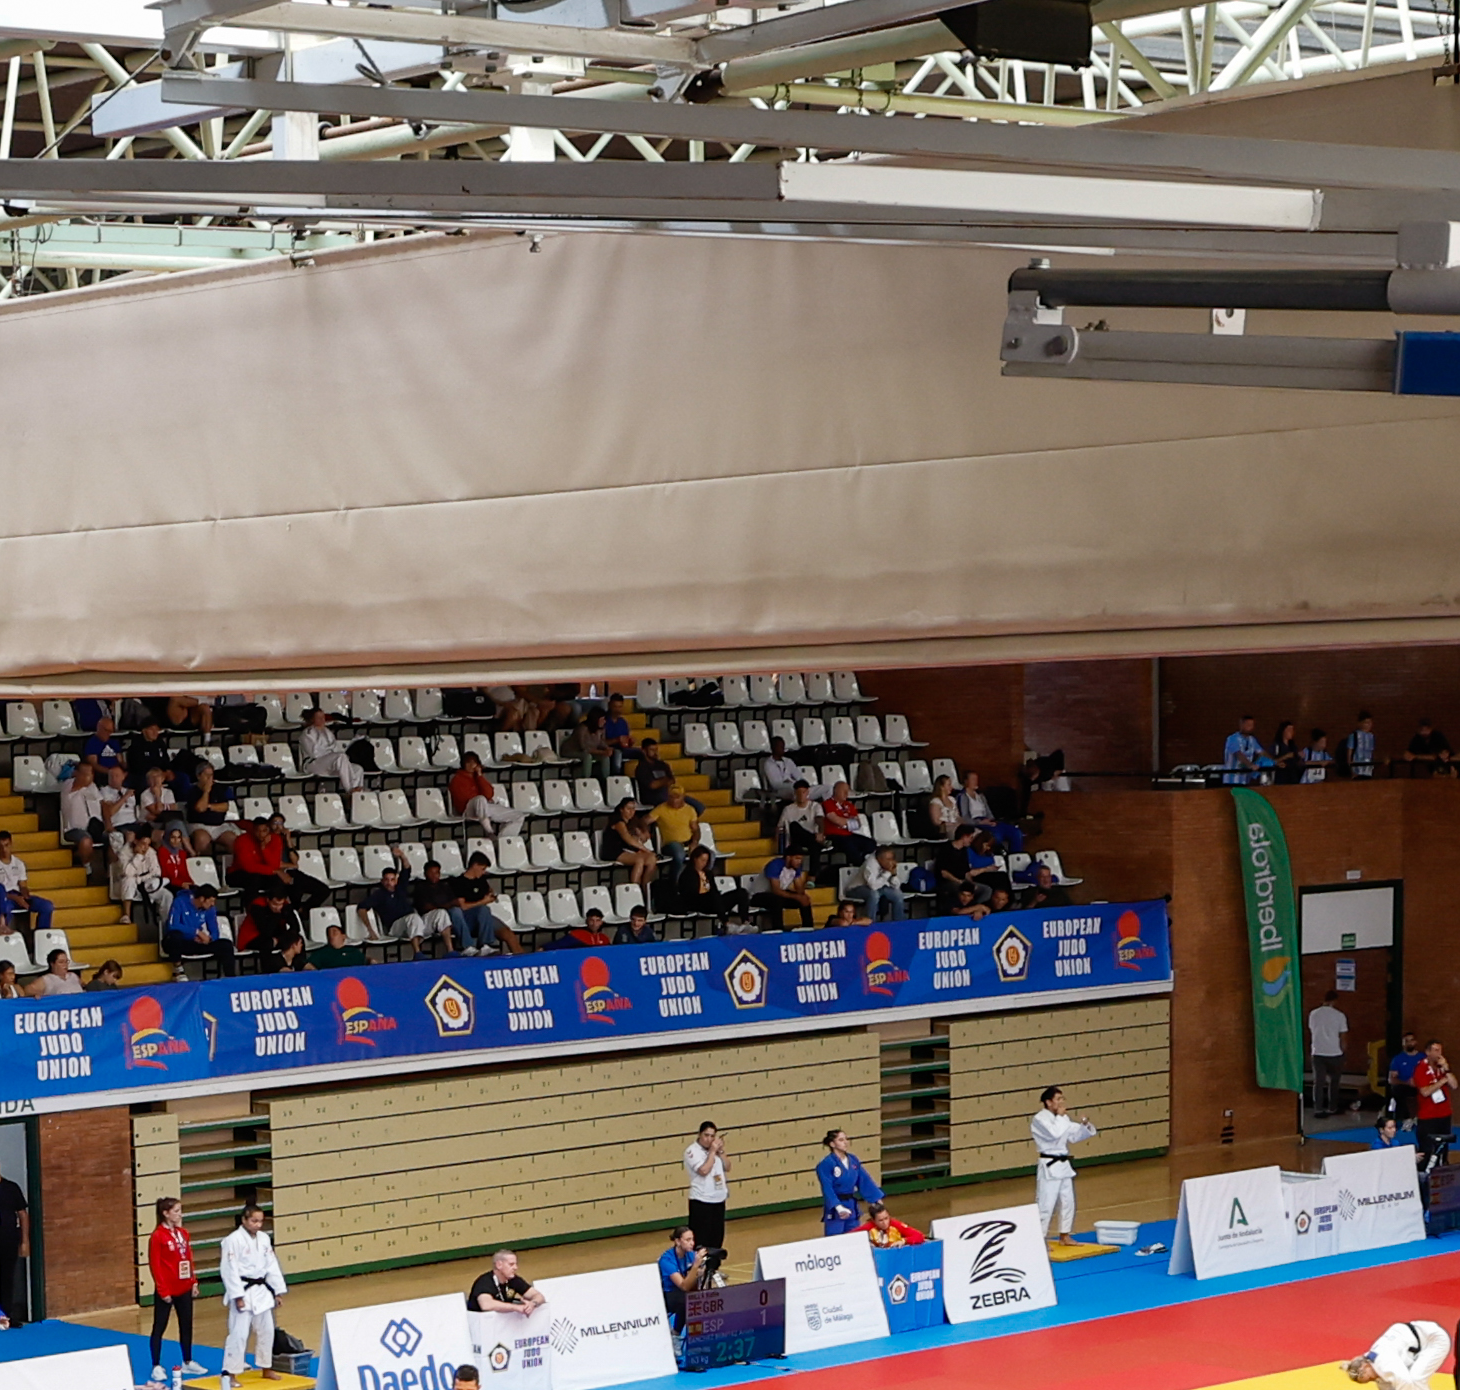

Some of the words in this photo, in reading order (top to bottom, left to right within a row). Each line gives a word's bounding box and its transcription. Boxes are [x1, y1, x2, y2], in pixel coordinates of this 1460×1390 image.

[1042, 917, 1101, 938] EUROPEAN
[780, 940, 846, 963] EUROPEAN
[1057, 937, 1088, 958] JUDO
[484, 965, 560, 990] EUROPEAN
[798, 962, 832, 983] JUDO
[1055, 957, 1091, 978] UNION
[230, 985, 313, 1013] EUROPEAN
[507, 988, 544, 1010] JUDO
[796, 982, 839, 1004] UNION
[13, 1006, 103, 1035] EUROPEAN
[255, 1010, 299, 1034] JUDO
[507, 1009, 554, 1032] UNION
[39, 1031, 84, 1056] JUDO
[254, 1032, 306, 1058] UNION
[36, 1055, 92, 1081] UNION
[1358, 1190, 1414, 1206] MILLENNIUM
[703, 1299, 724, 1313] GBR
[760, 1289, 768, 1306] 0
[822, 1305, 843, 1315] Ciudad
[970, 1287, 1031, 1310] ZEBRA
[580, 1314, 661, 1342] MILLENNIUM
[703, 1319, 724, 1333] ESP
[760, 1309, 766, 1325] 1
[716, 1336, 756, 1362] 2:37
